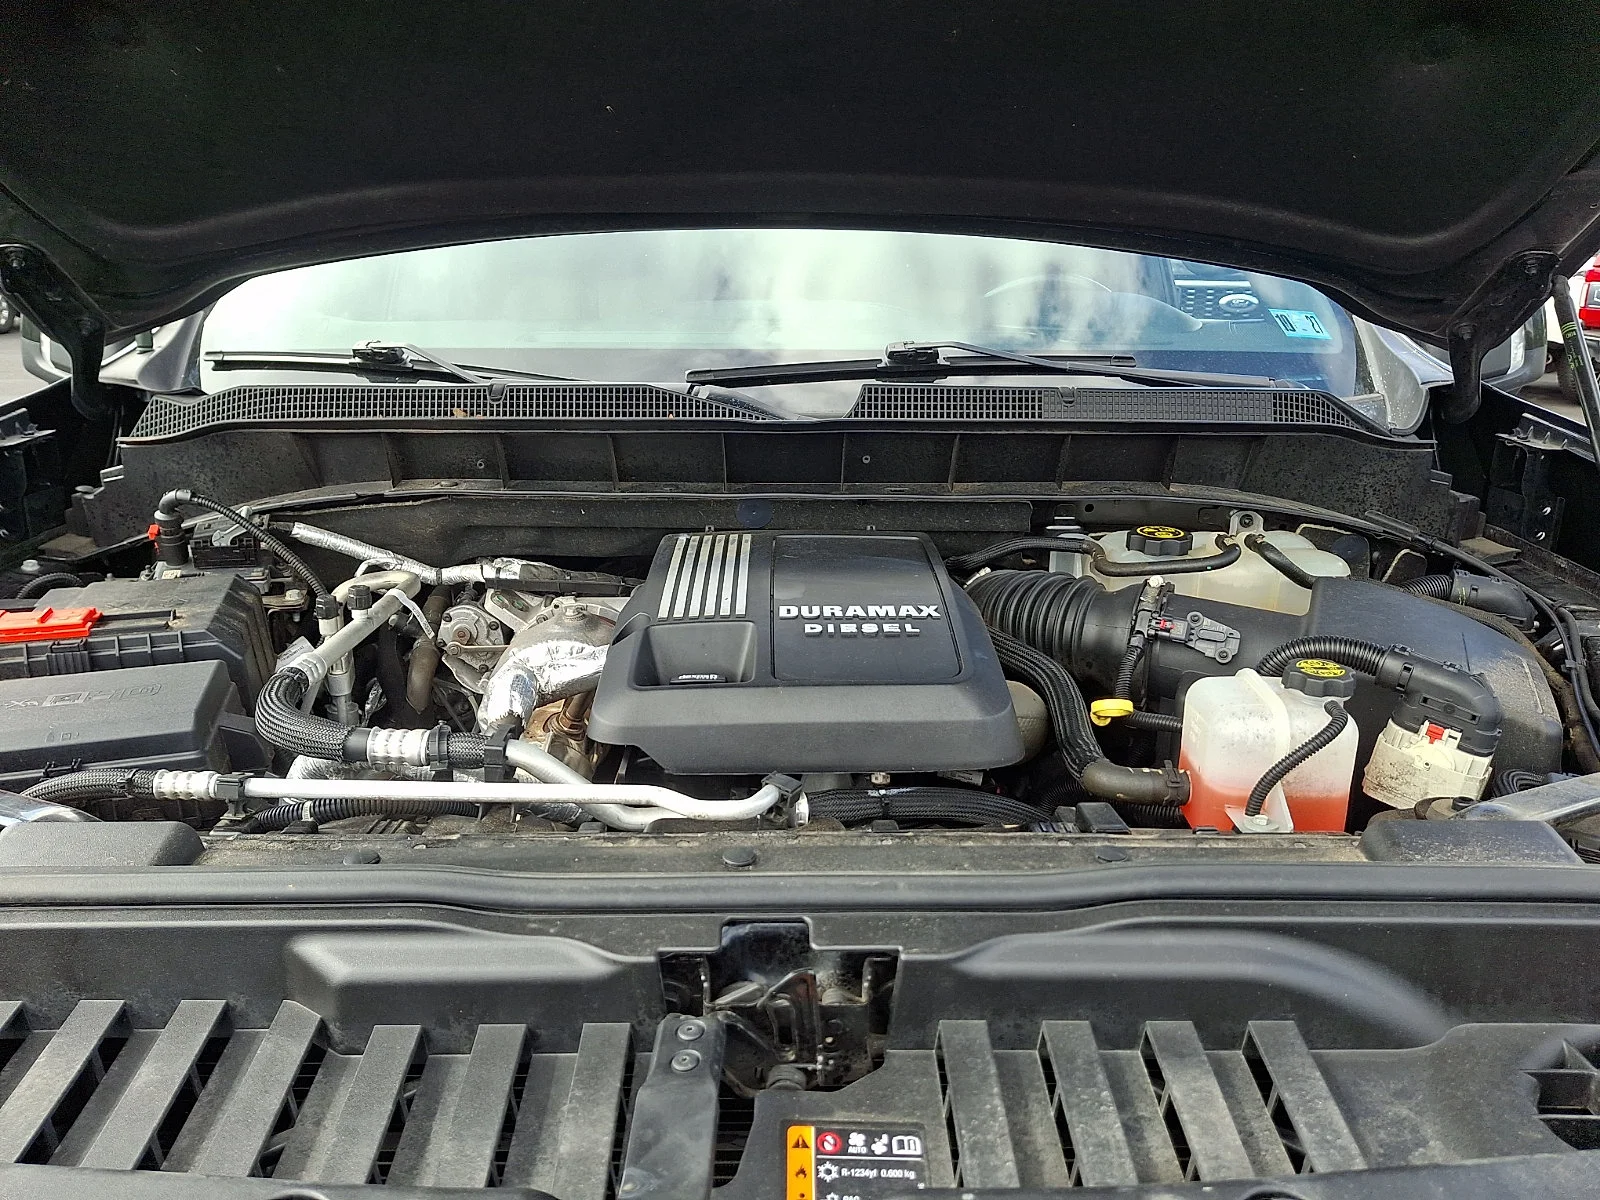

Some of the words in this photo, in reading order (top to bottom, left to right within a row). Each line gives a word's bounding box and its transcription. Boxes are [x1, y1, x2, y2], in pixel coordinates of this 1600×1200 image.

[778, 605, 942, 620] DURAMAX
[804, 623, 921, 636] DIESEL
[847, 1146, 867, 1154] AUTO
